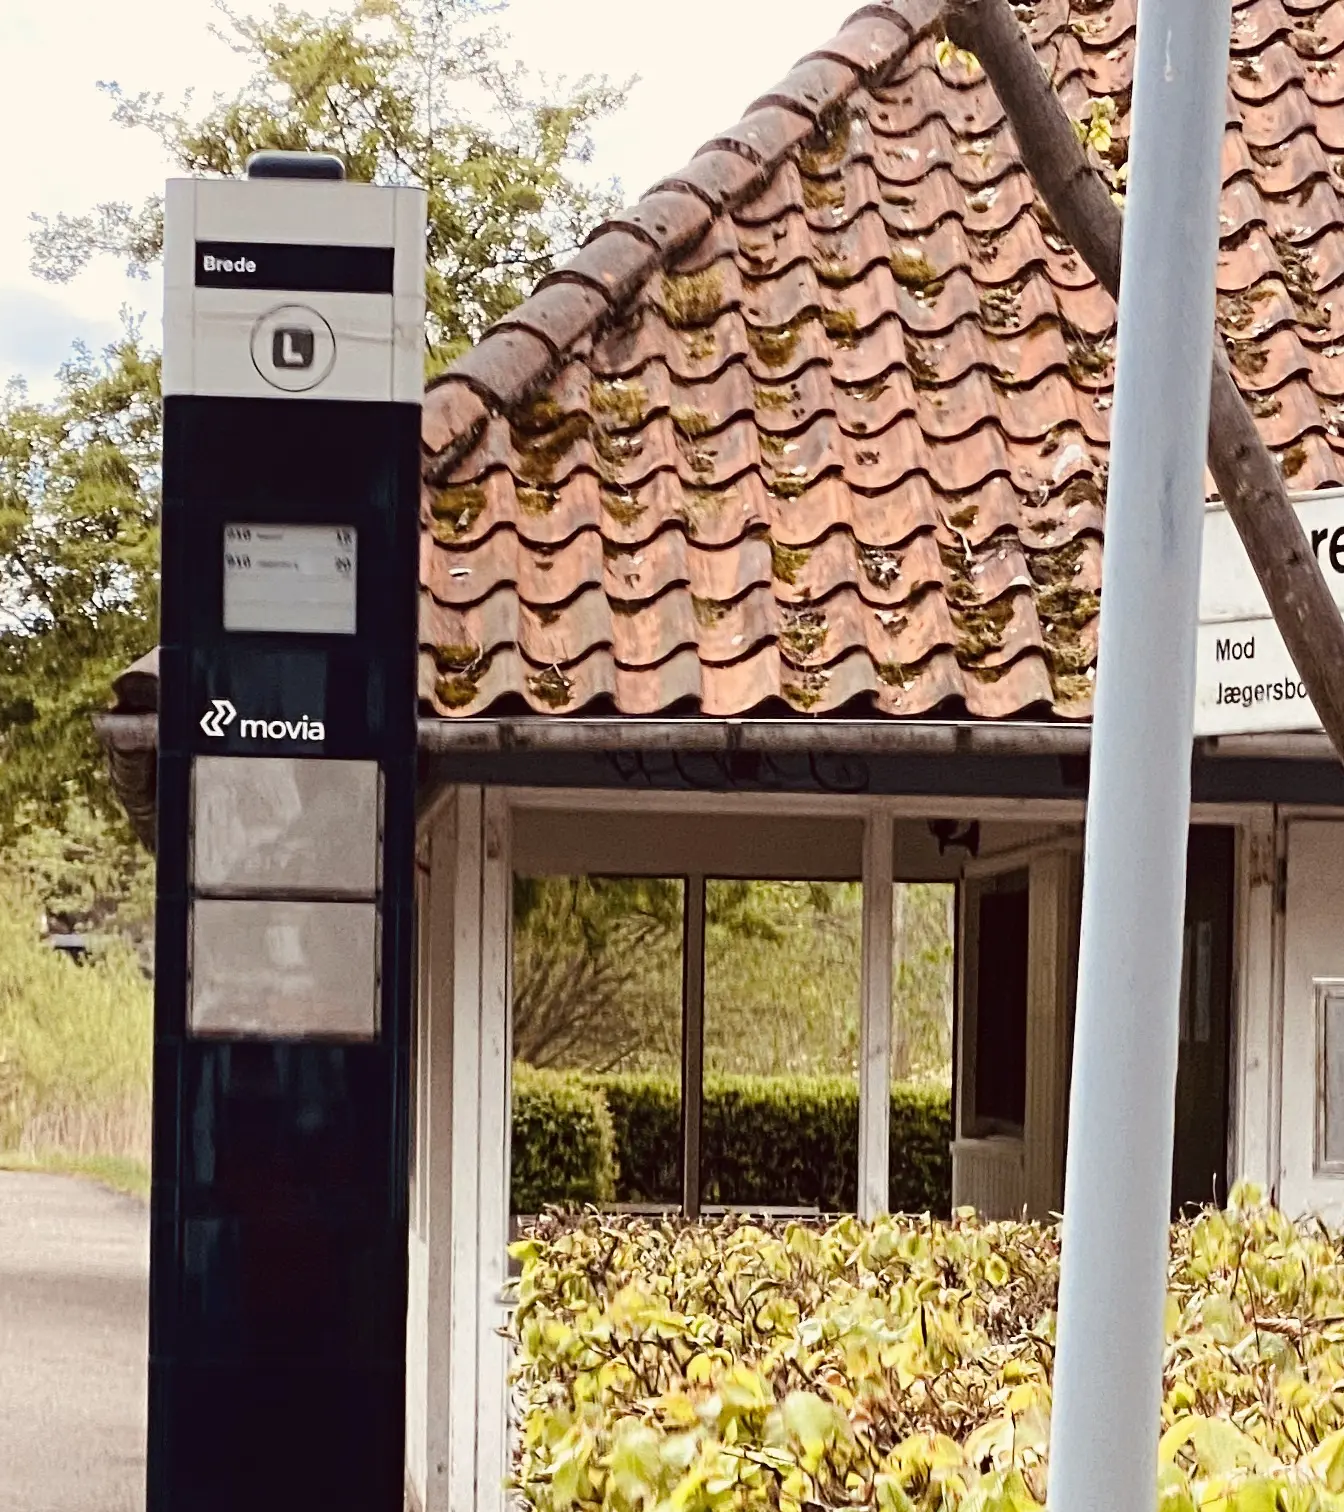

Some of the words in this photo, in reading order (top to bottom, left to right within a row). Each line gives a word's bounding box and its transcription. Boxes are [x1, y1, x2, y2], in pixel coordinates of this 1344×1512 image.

[203, 255, 256, 272] Brede
[1216, 636, 1255, 661] Mod
[1216, 677, 1308, 708] Jægersbo
[240, 715, 326, 741] movia
